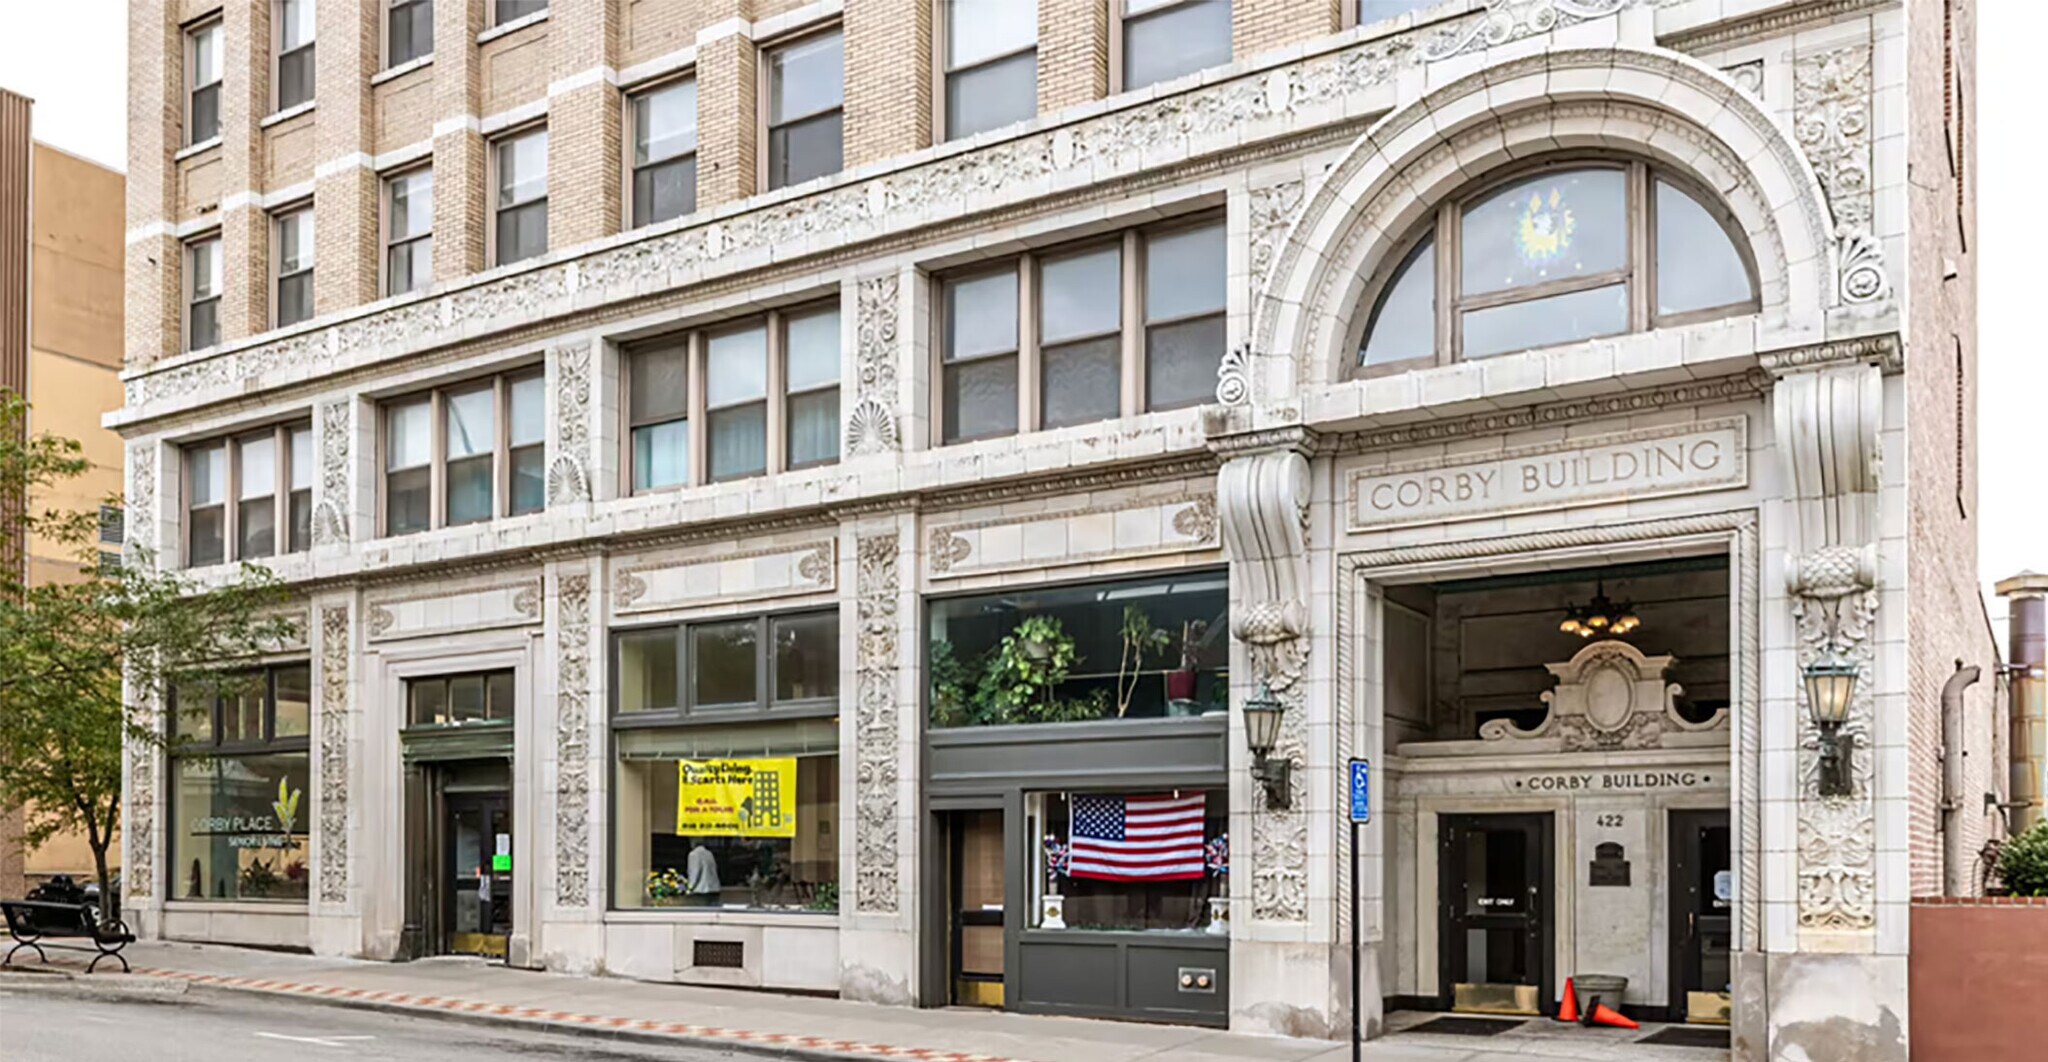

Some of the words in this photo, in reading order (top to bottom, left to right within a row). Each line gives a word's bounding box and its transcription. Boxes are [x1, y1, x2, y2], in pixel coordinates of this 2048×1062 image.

[1370, 468, 1497, 511] CORBY
[1521, 440, 1721, 493] BUILDING
[1528, 775, 1593, 790] CORBY
[1602, 773, 1696, 789] BUILDING
[190, 816, 231, 831] CORBY
[233, 816, 272, 831] PLACE
[1596, 814, 1624, 827] 422
